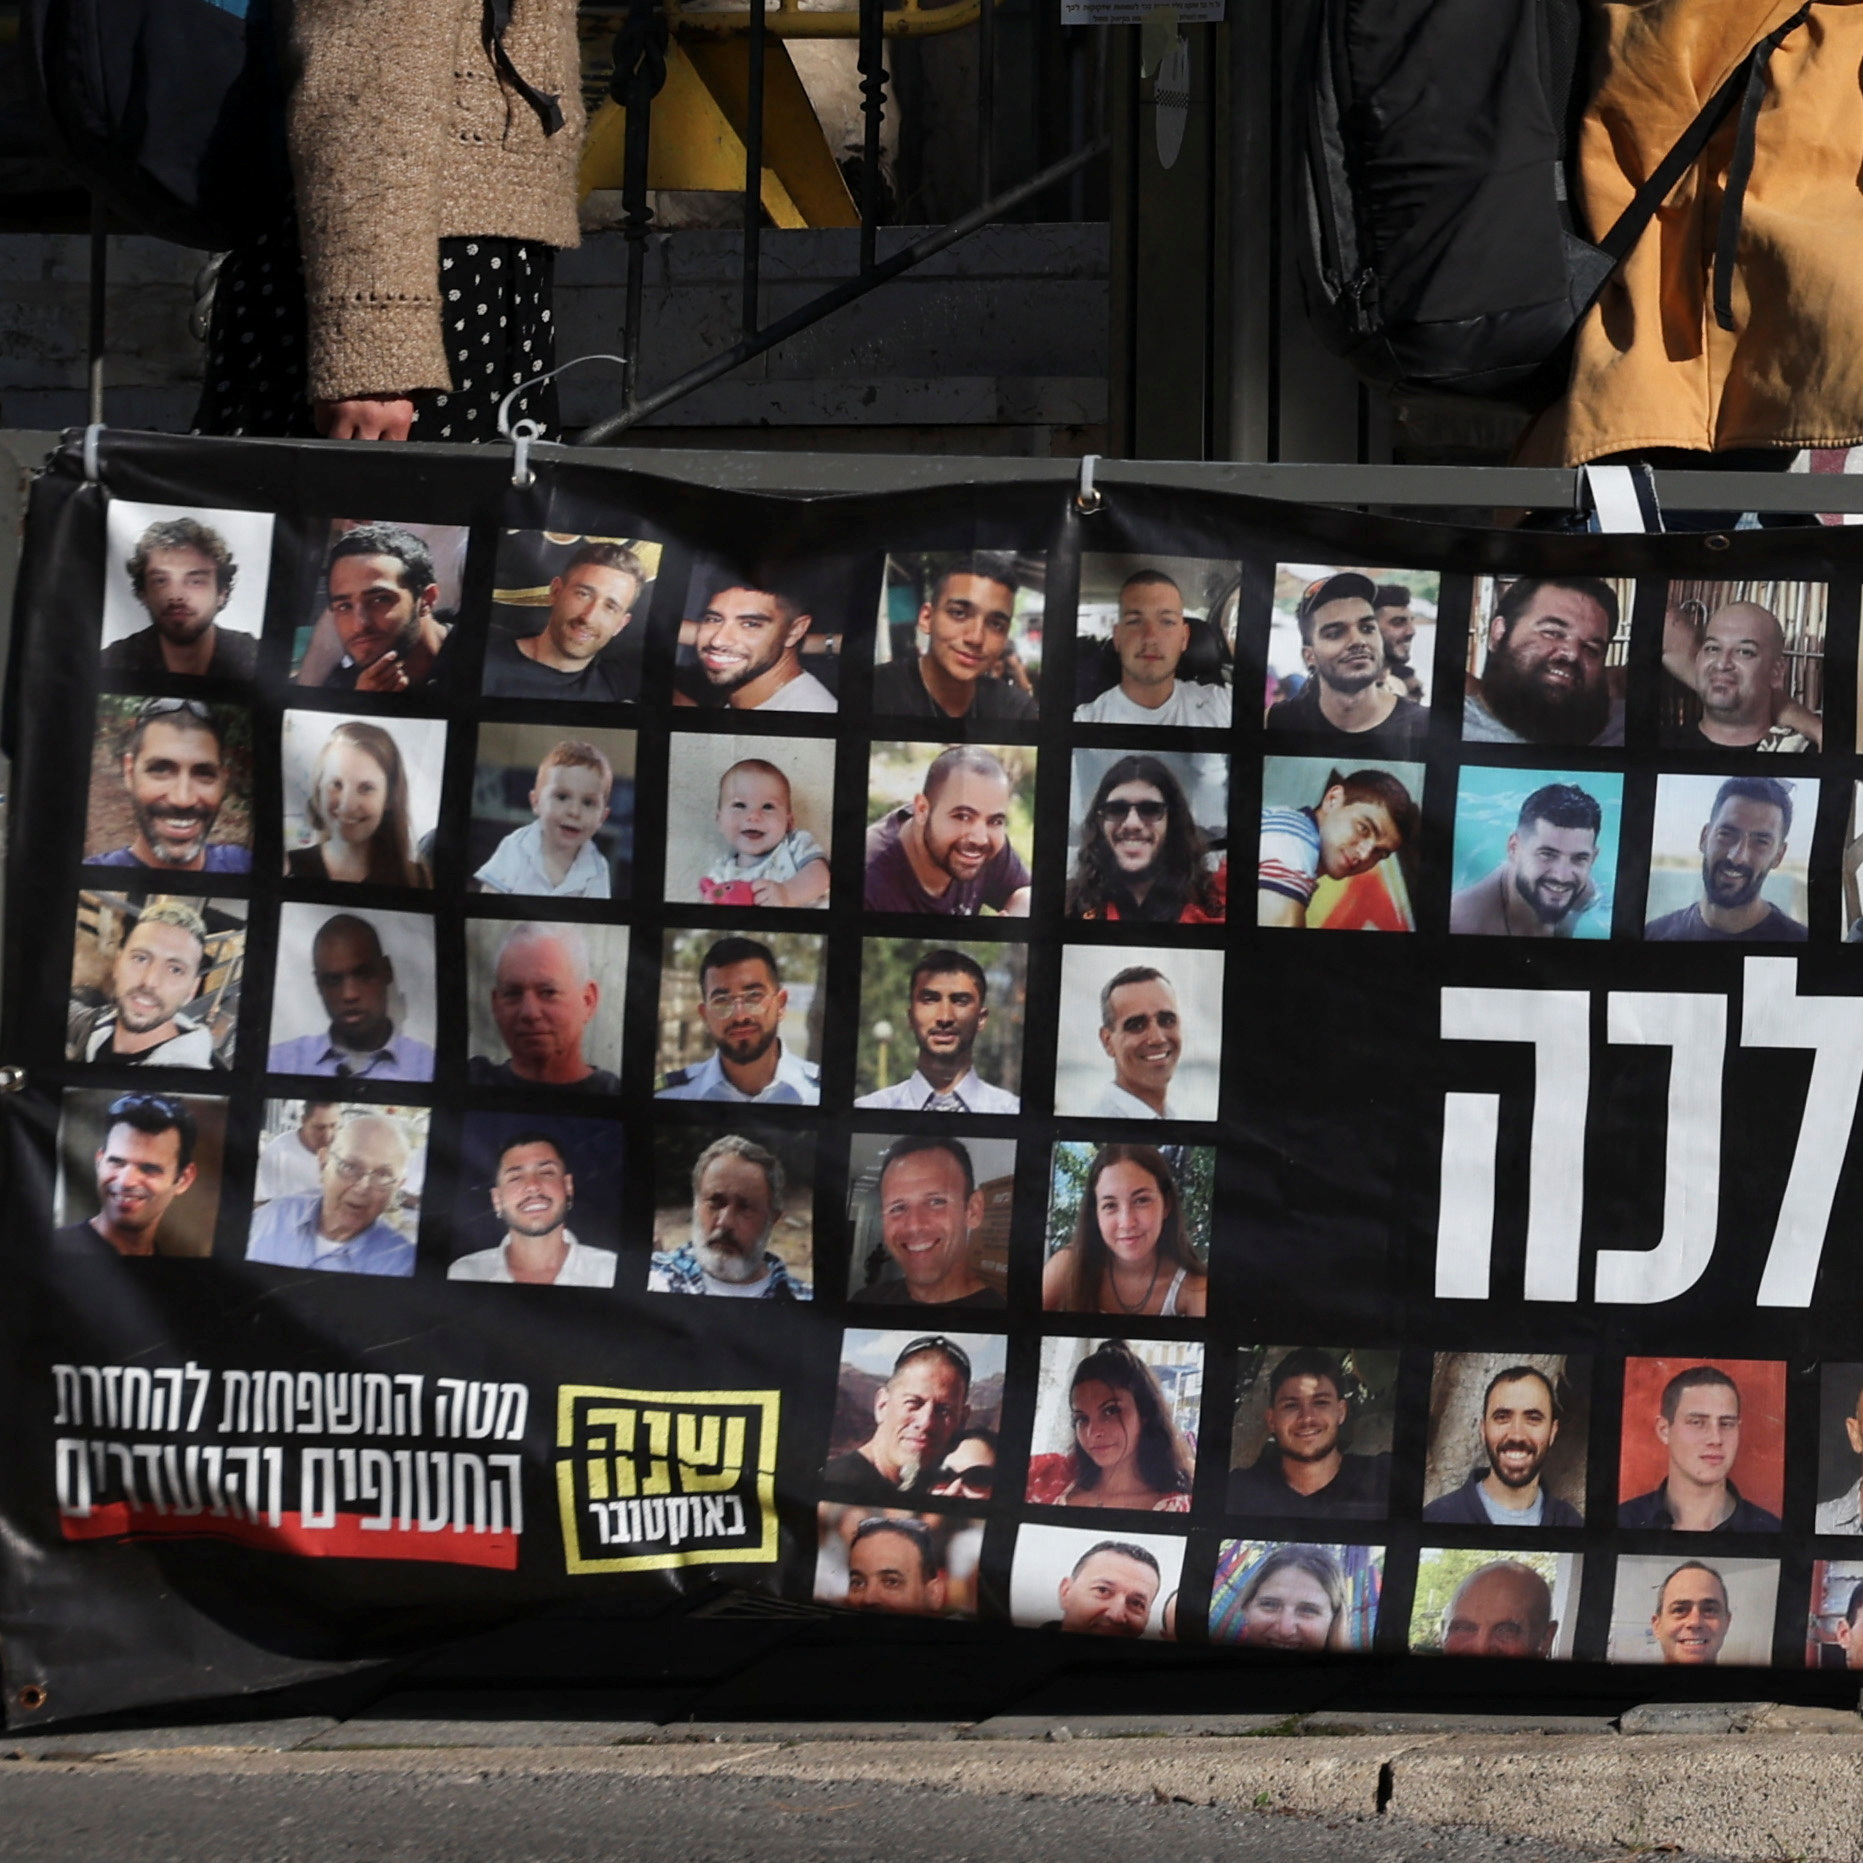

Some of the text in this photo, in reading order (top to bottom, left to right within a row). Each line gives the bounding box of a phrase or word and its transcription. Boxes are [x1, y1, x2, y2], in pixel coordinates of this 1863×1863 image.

[53, 1361, 528, 1441] מטה המשפחות להחזרת
[56, 1438, 523, 1534] החטופים והנעדרים
[586, 1408, 746, 1500] שנה
[589, 1492, 746, 1545] באוקטובר
